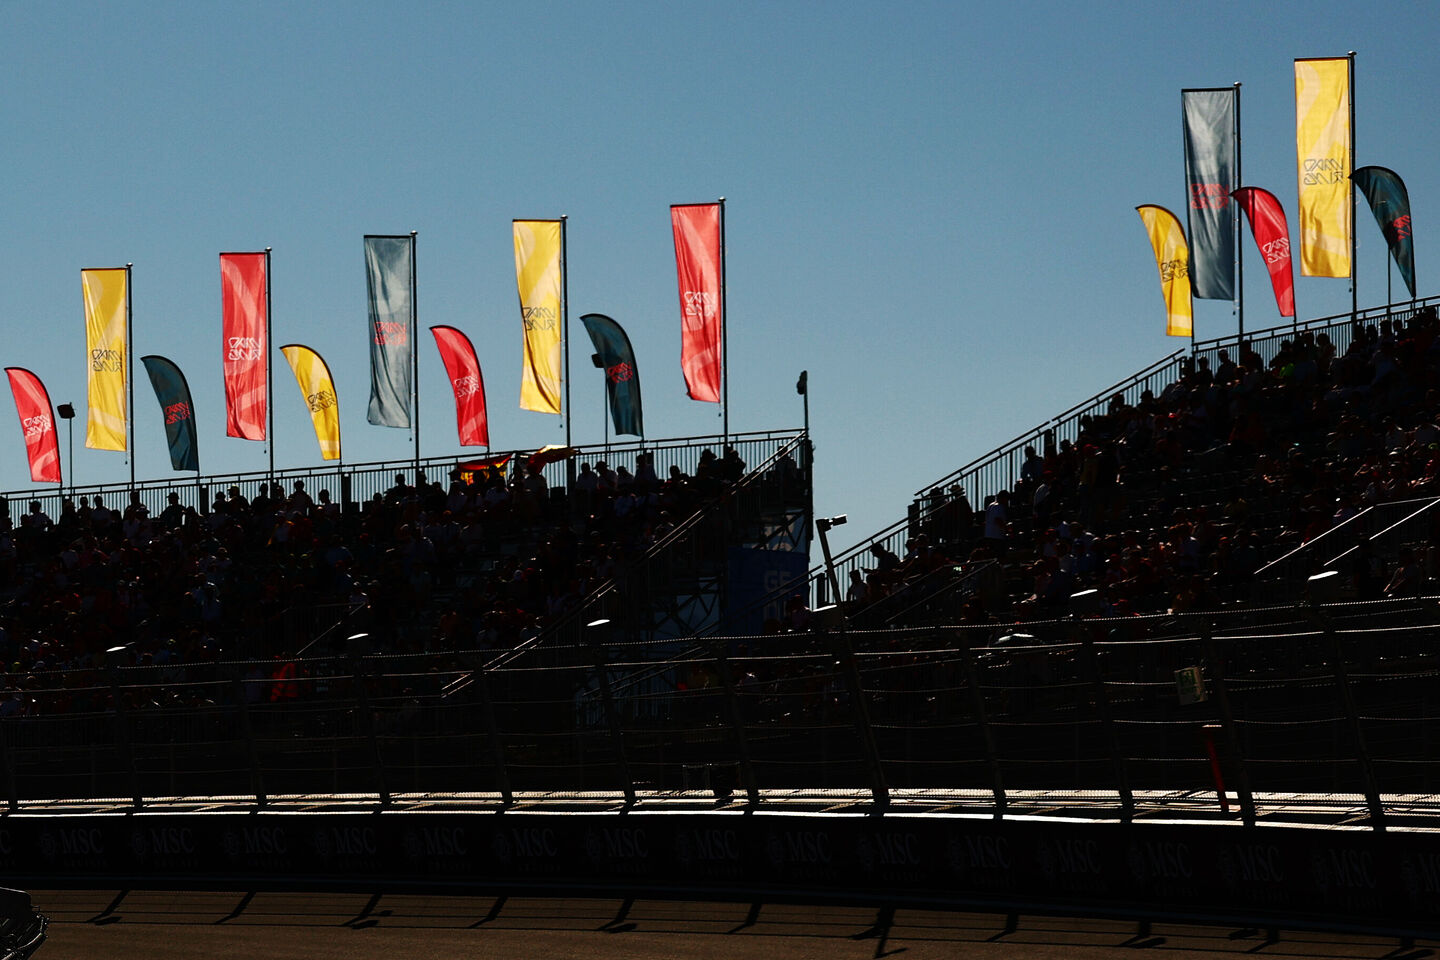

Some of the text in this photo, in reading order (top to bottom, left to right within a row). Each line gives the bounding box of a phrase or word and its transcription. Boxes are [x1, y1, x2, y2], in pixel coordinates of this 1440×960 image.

[60, 828, 105, 855] MSC
[149, 827, 195, 854] MSC
[243, 827, 288, 854] MSC
[332, 827, 377, 855] MSC
[422, 827, 468, 855] MSC
[511, 827, 558, 857] MSC
[603, 828, 649, 858] MSC
